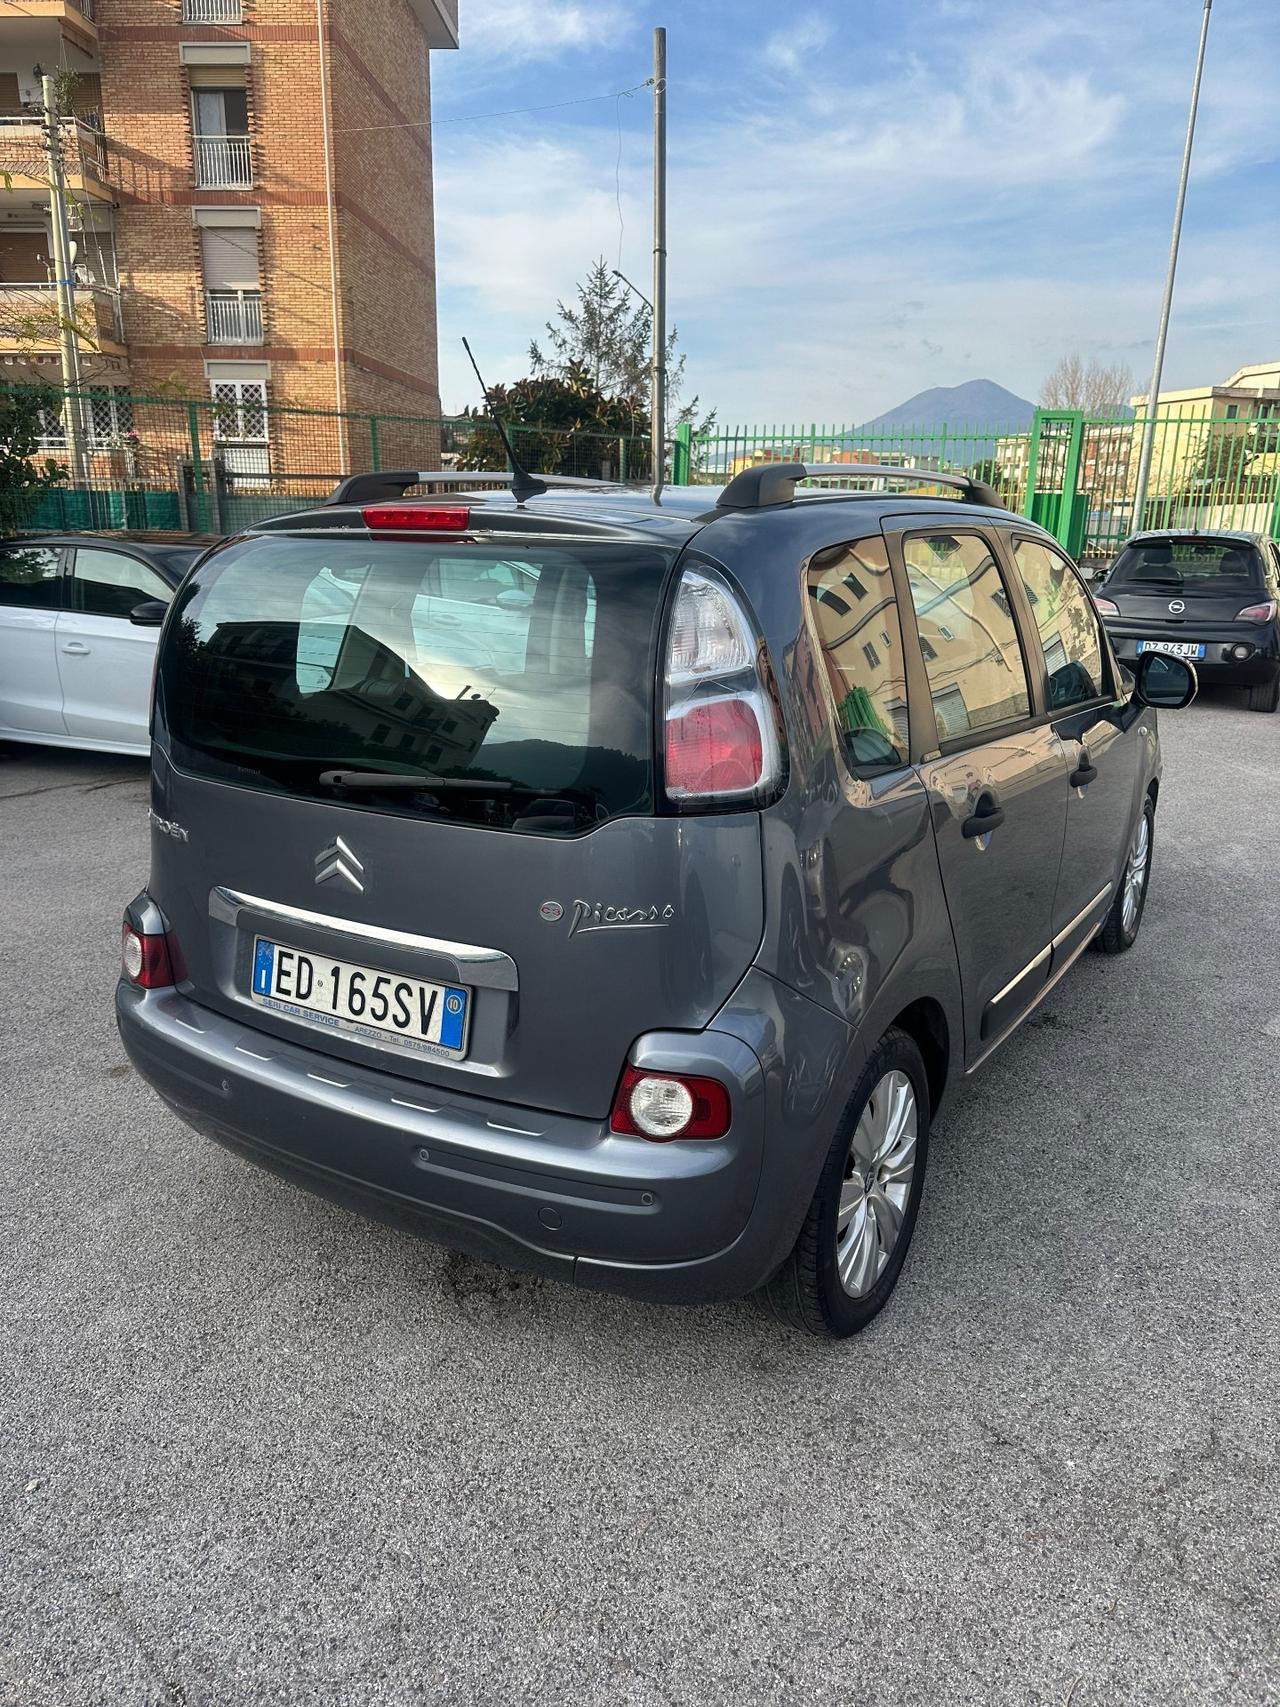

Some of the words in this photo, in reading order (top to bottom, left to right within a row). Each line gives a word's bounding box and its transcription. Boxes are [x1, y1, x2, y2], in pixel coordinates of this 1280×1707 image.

[567, 899, 675, 939] Picasso
[275, 950, 314, 1001] ED
[330, 965, 438, 1036] 165SV
[262, 998, 281, 1010] SERI
[283, 1004, 301, 1016] CAR
[302, 1009, 340, 1027] SERVICE
[354, 1026, 382, 1039] AREZZO
